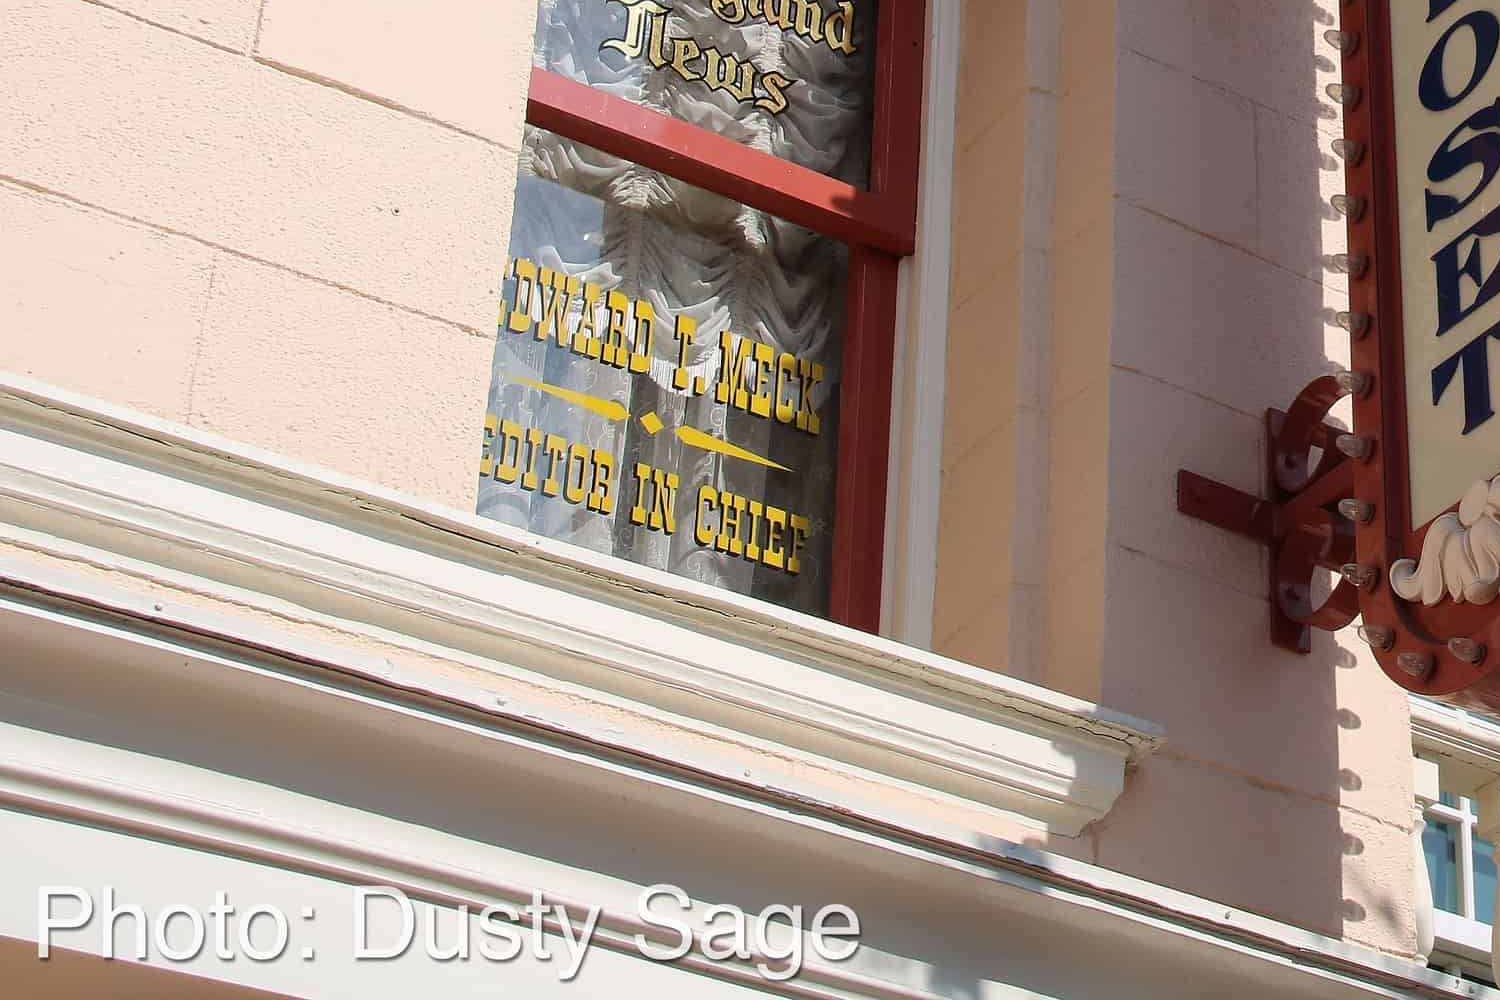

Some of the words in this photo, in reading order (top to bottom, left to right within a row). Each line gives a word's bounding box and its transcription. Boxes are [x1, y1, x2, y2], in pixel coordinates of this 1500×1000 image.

[673, 315, 704, 395] T.
[716, 330, 824, 435] MECK
[480, 414, 615, 514] EDITOR
[631, 462, 680, 535] IN
[695, 485, 808, 575] CHIEF
